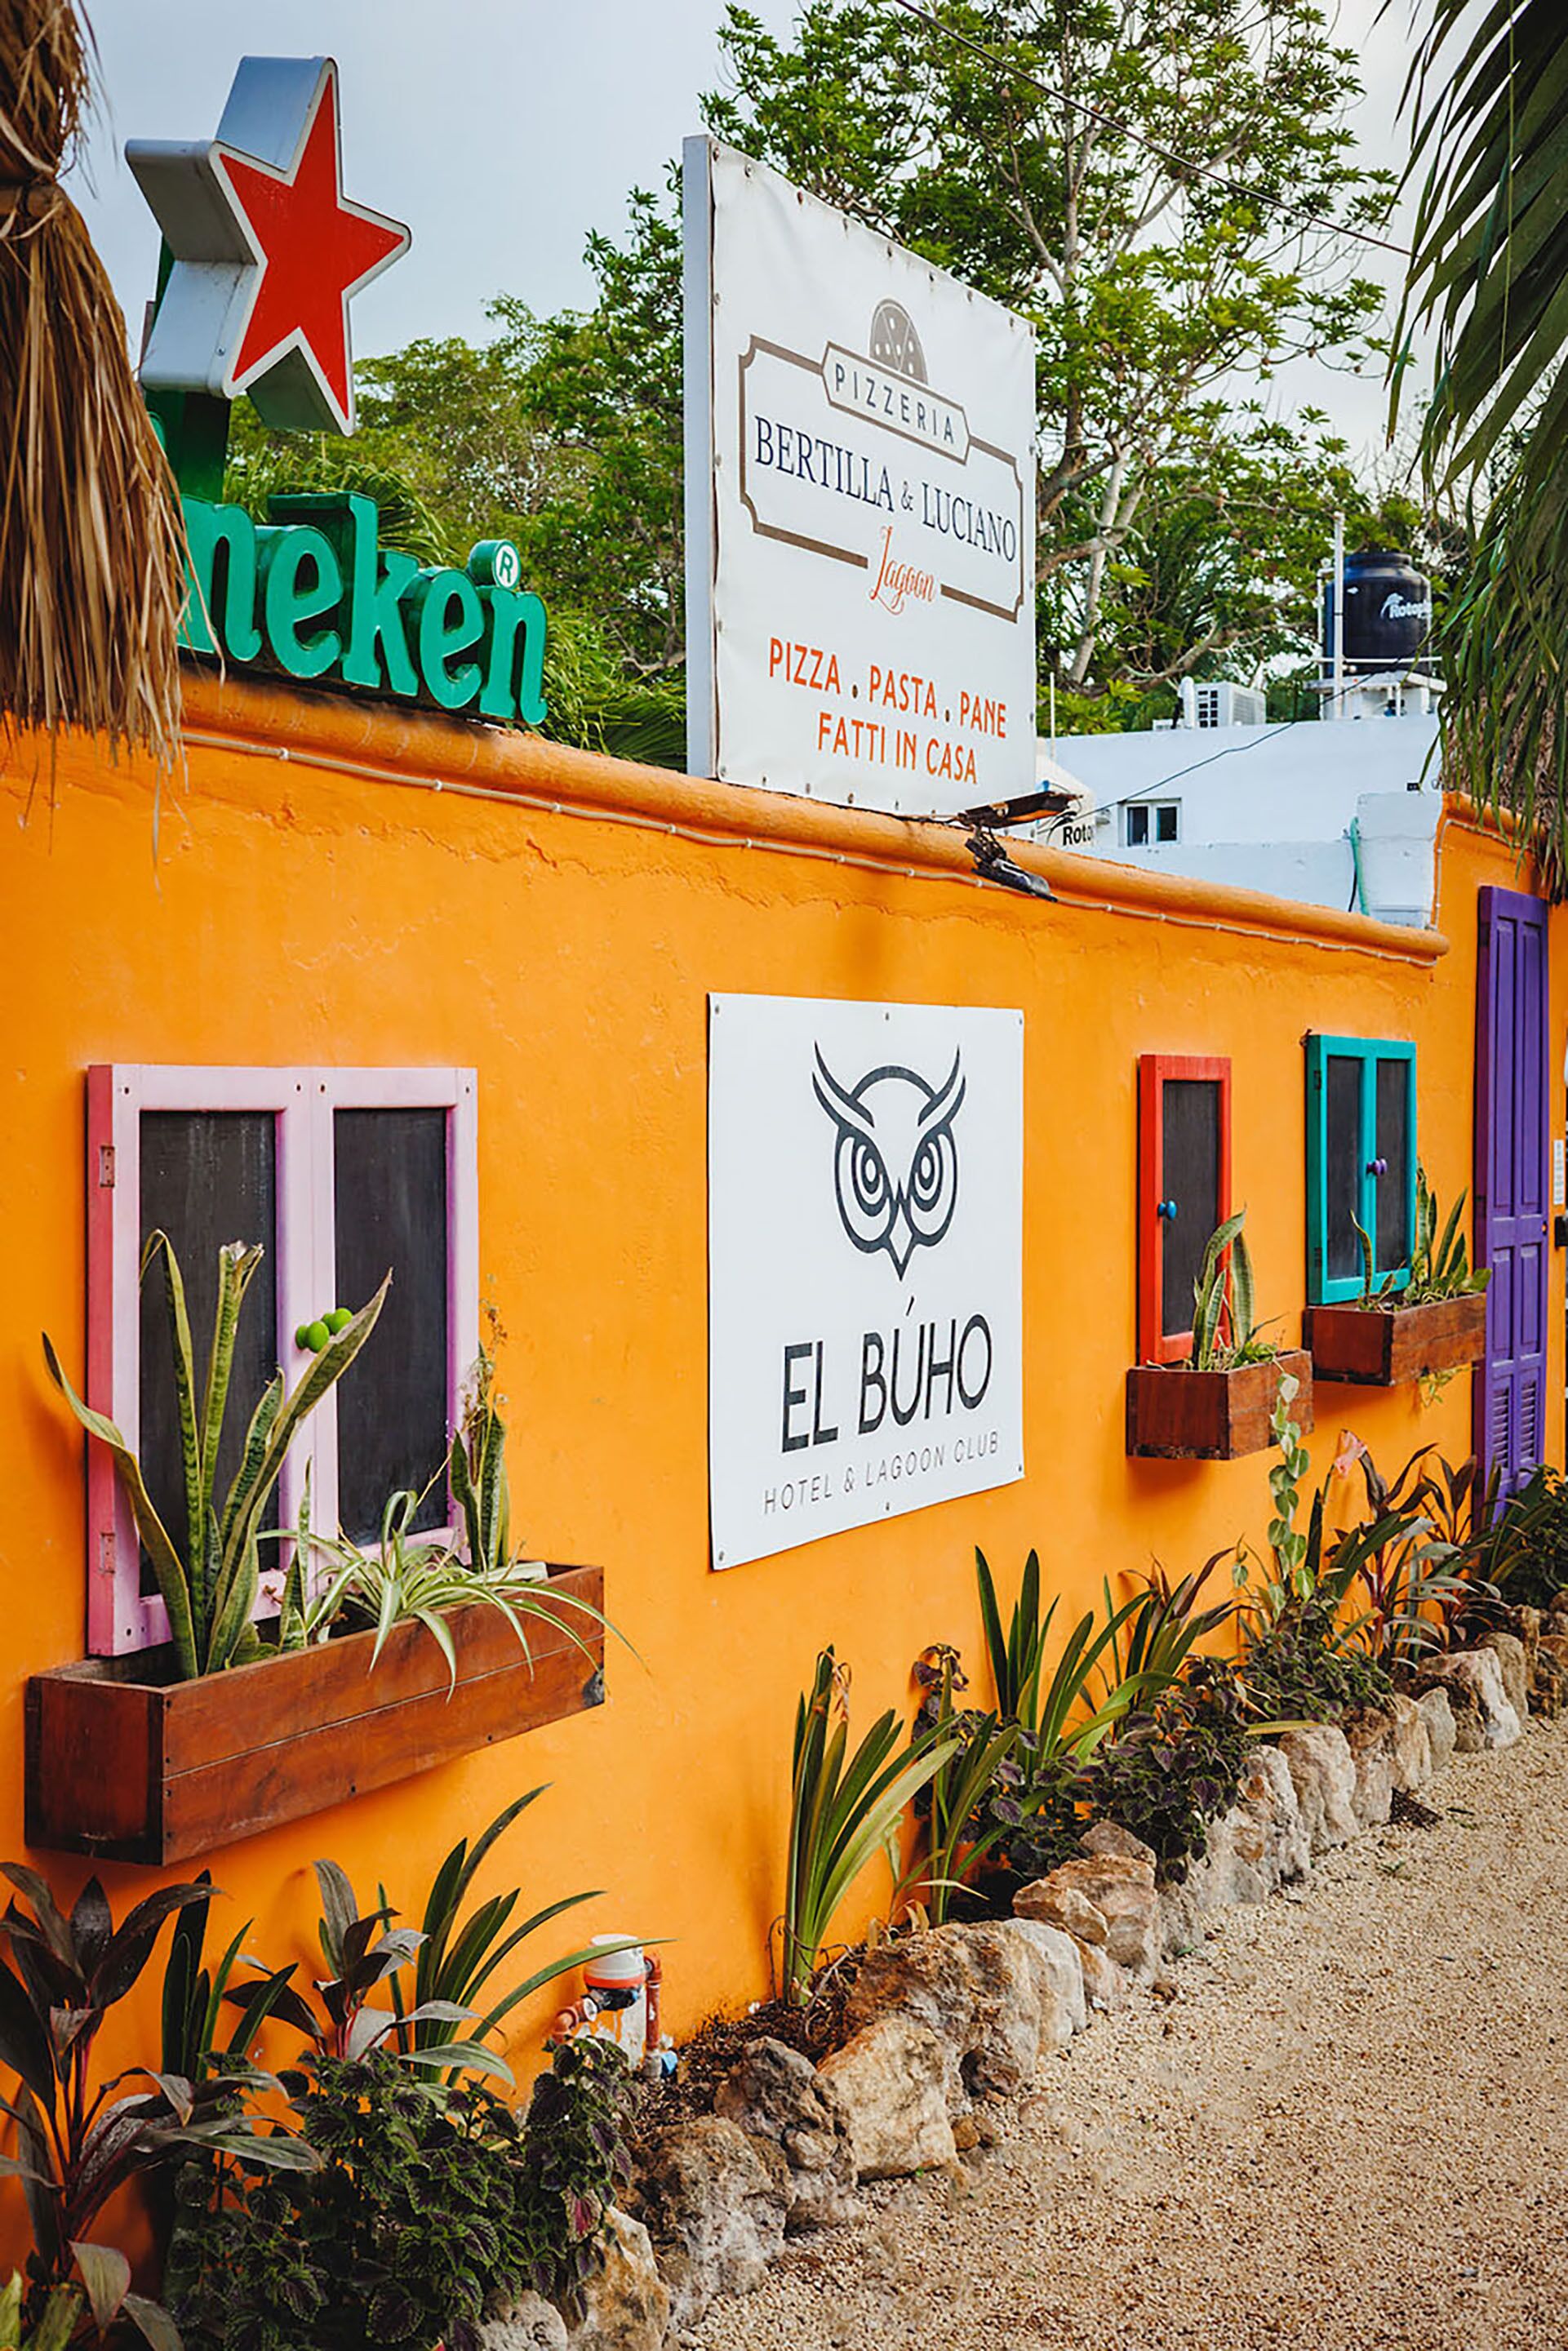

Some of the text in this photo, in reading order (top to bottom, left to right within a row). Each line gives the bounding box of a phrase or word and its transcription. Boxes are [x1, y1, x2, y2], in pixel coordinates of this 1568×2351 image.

[835, 363, 954, 444] PIZZERIA
[755, 415, 1016, 562] BERTILLA & LUCIANO
[175, 491, 548, 725] neken
[869, 525, 935, 615] Lagoon
[769, 637, 1006, 739] PIZZA PASTA PANE
[818, 711, 978, 784] FATTI IN CASA
[1063, 824, 1094, 846] Roto
[782, 1295, 993, 1453] EL BÚHO
[764, 1431, 998, 1514] HOTEL & LAGOON CLUB
